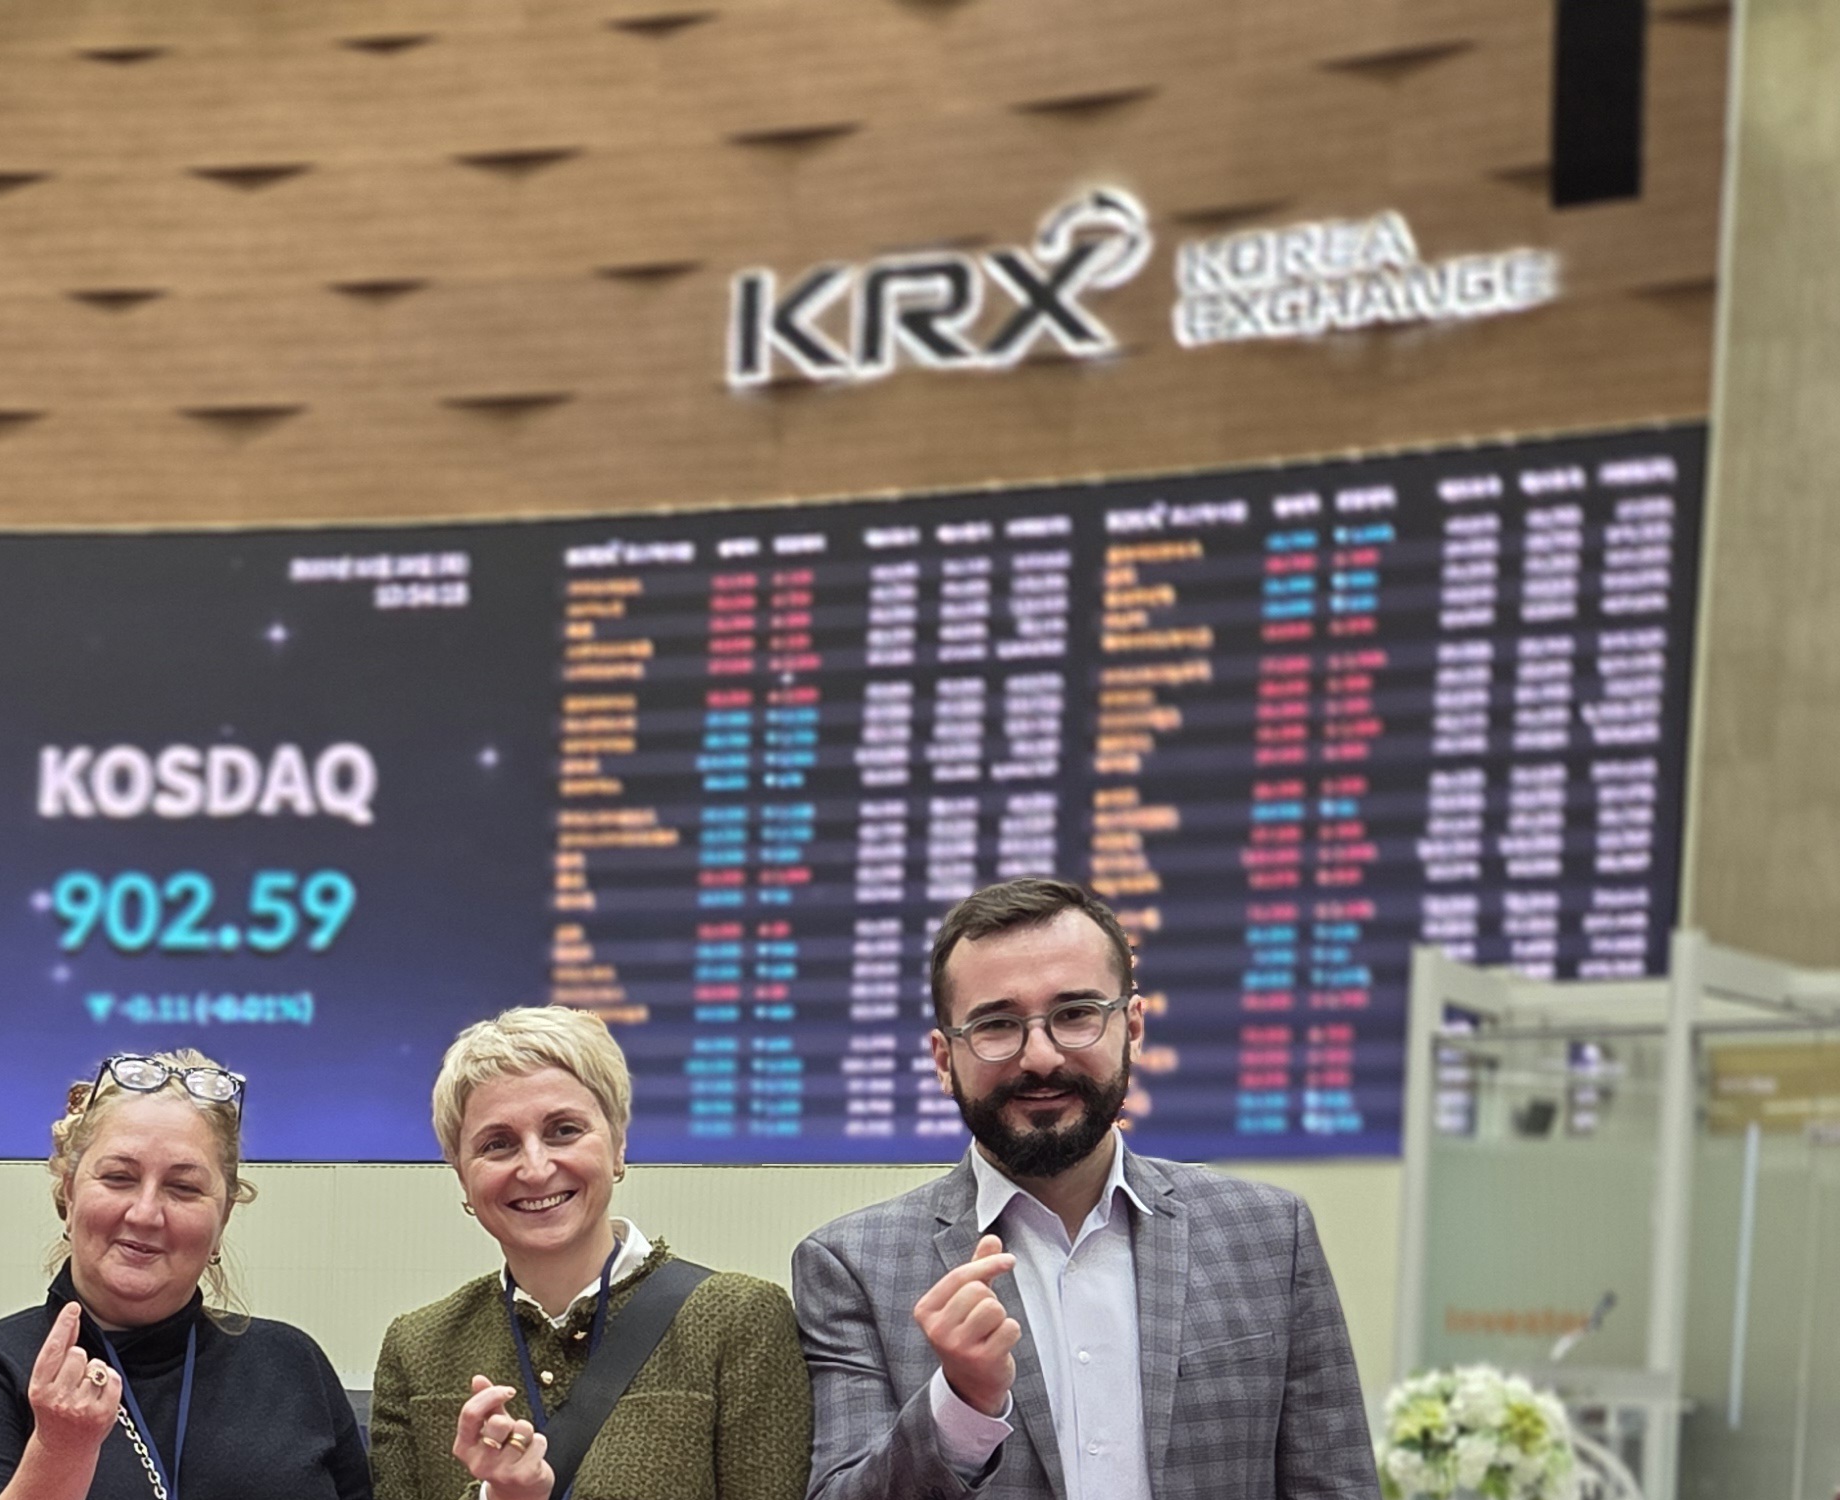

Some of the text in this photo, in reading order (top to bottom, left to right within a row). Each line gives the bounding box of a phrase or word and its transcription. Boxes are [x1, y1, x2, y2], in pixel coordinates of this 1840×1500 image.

[1178, 212, 1416, 292] KOREA
[728, 225, 1125, 386] KRX
[1175, 250, 1560, 346] EXCHANGE
[38, 744, 377, 824] KOSDAQ
[52, 871, 356, 952] 902.59
